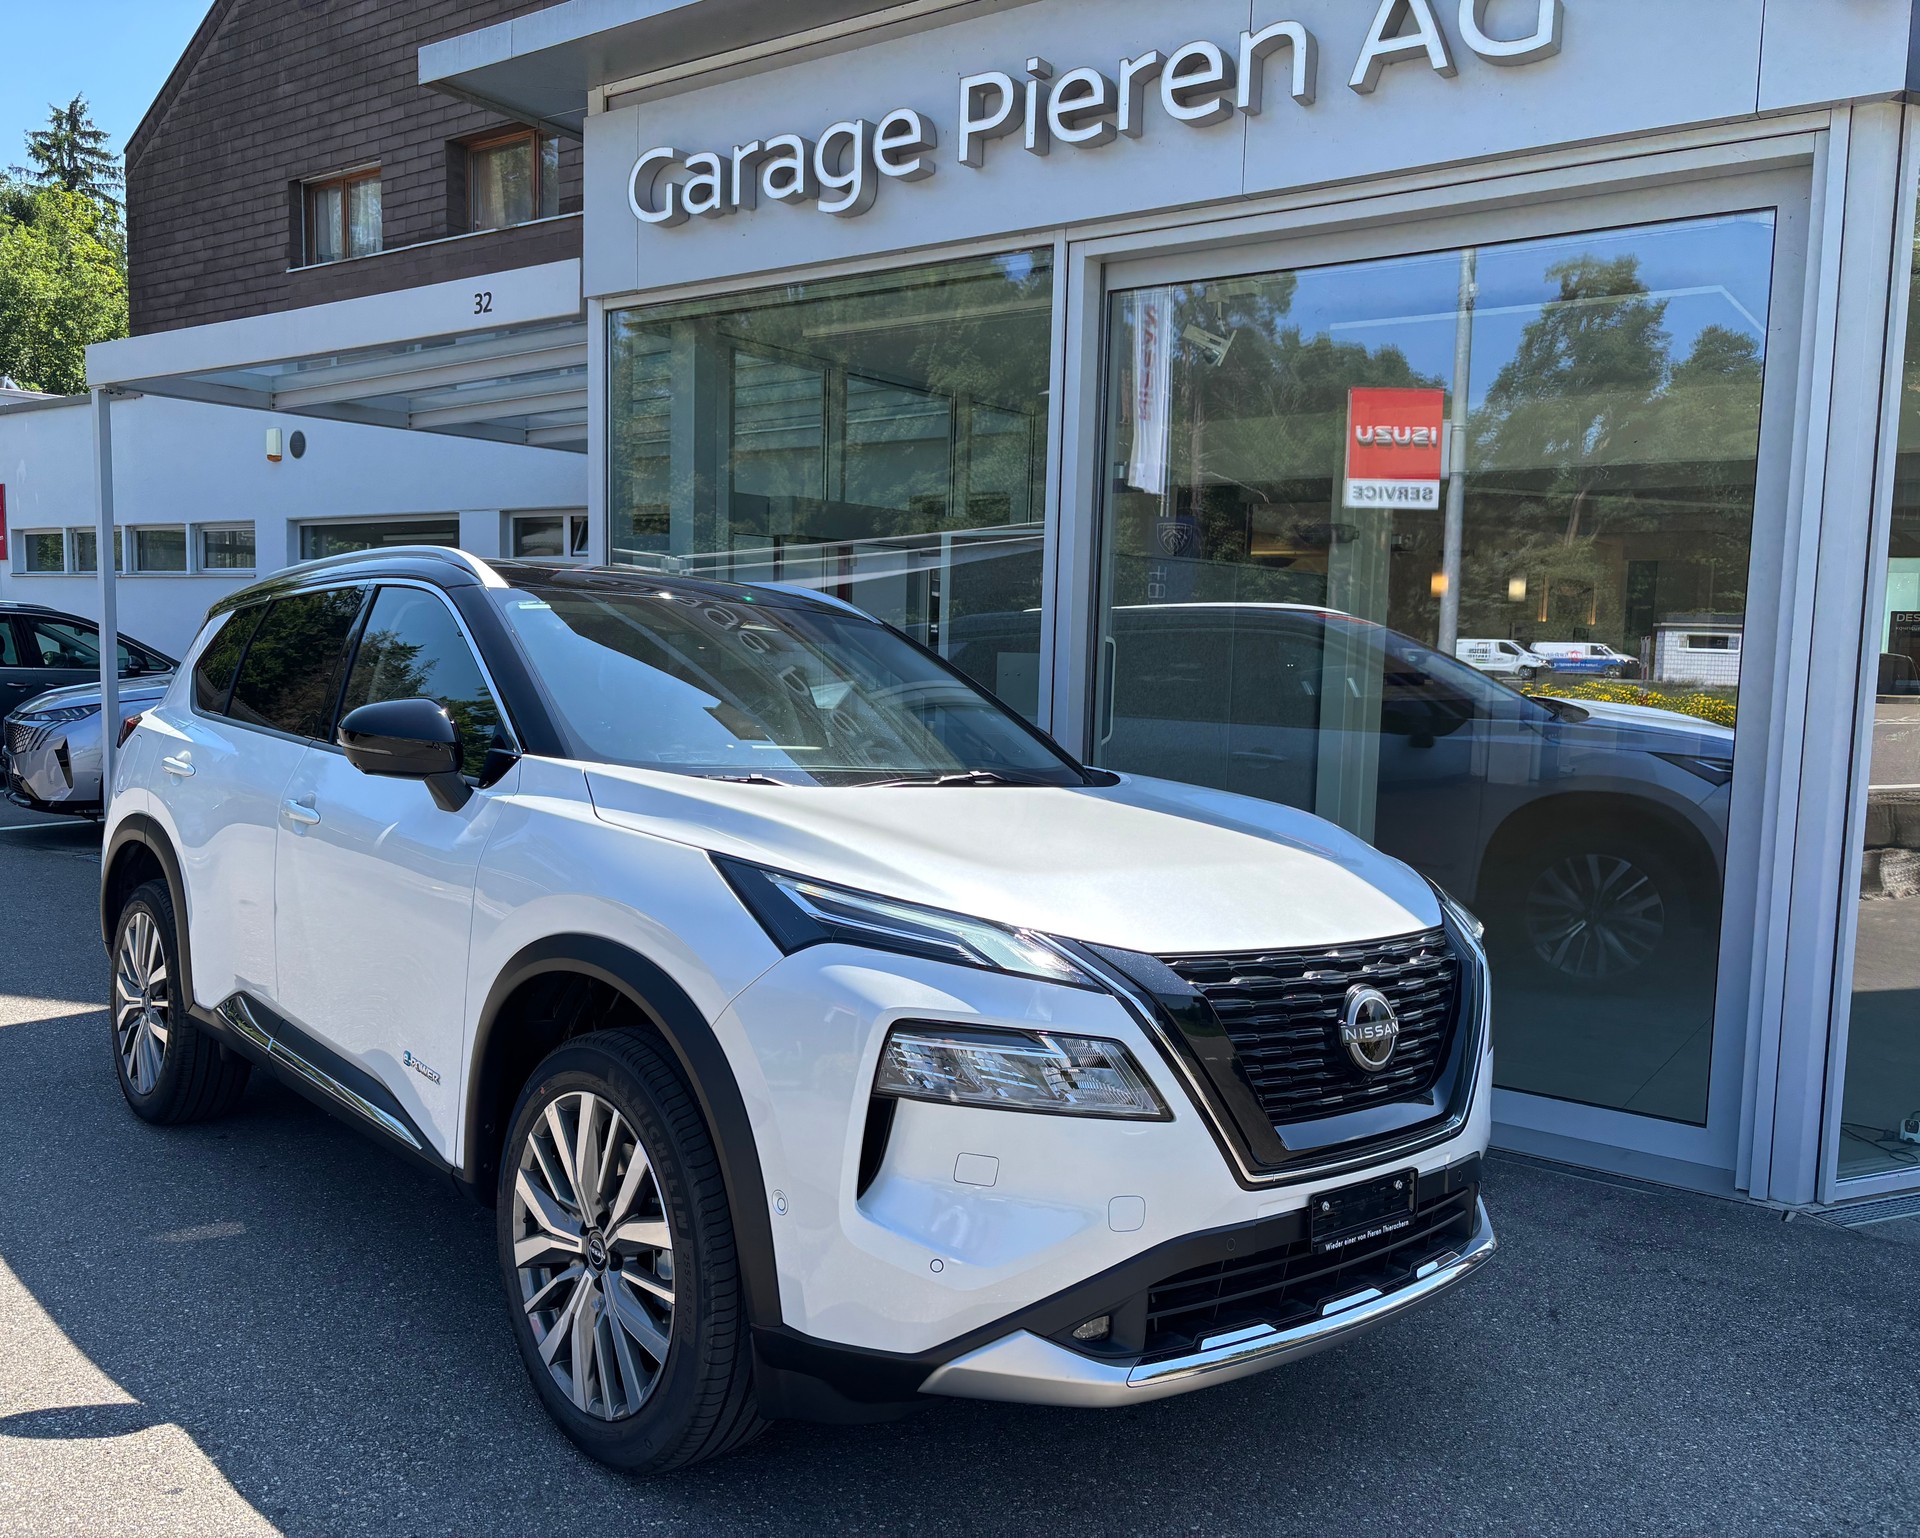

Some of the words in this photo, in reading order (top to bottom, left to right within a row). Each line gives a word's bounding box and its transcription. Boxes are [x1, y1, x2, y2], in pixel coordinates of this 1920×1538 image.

[627, 107, 937, 228] Garage
[957, 19, 1319, 168] Pieren
[474, 291, 493, 315] 32
[1345, 1021, 1399, 1041] NISSAN
[632, 1098, 689, 1230] MICHELIN
[1325, 1240, 1343, 1251] Wieder
[1344, 1236, 1356, 1246] einer
[1367, 1229, 1382, 1238] Pieren
